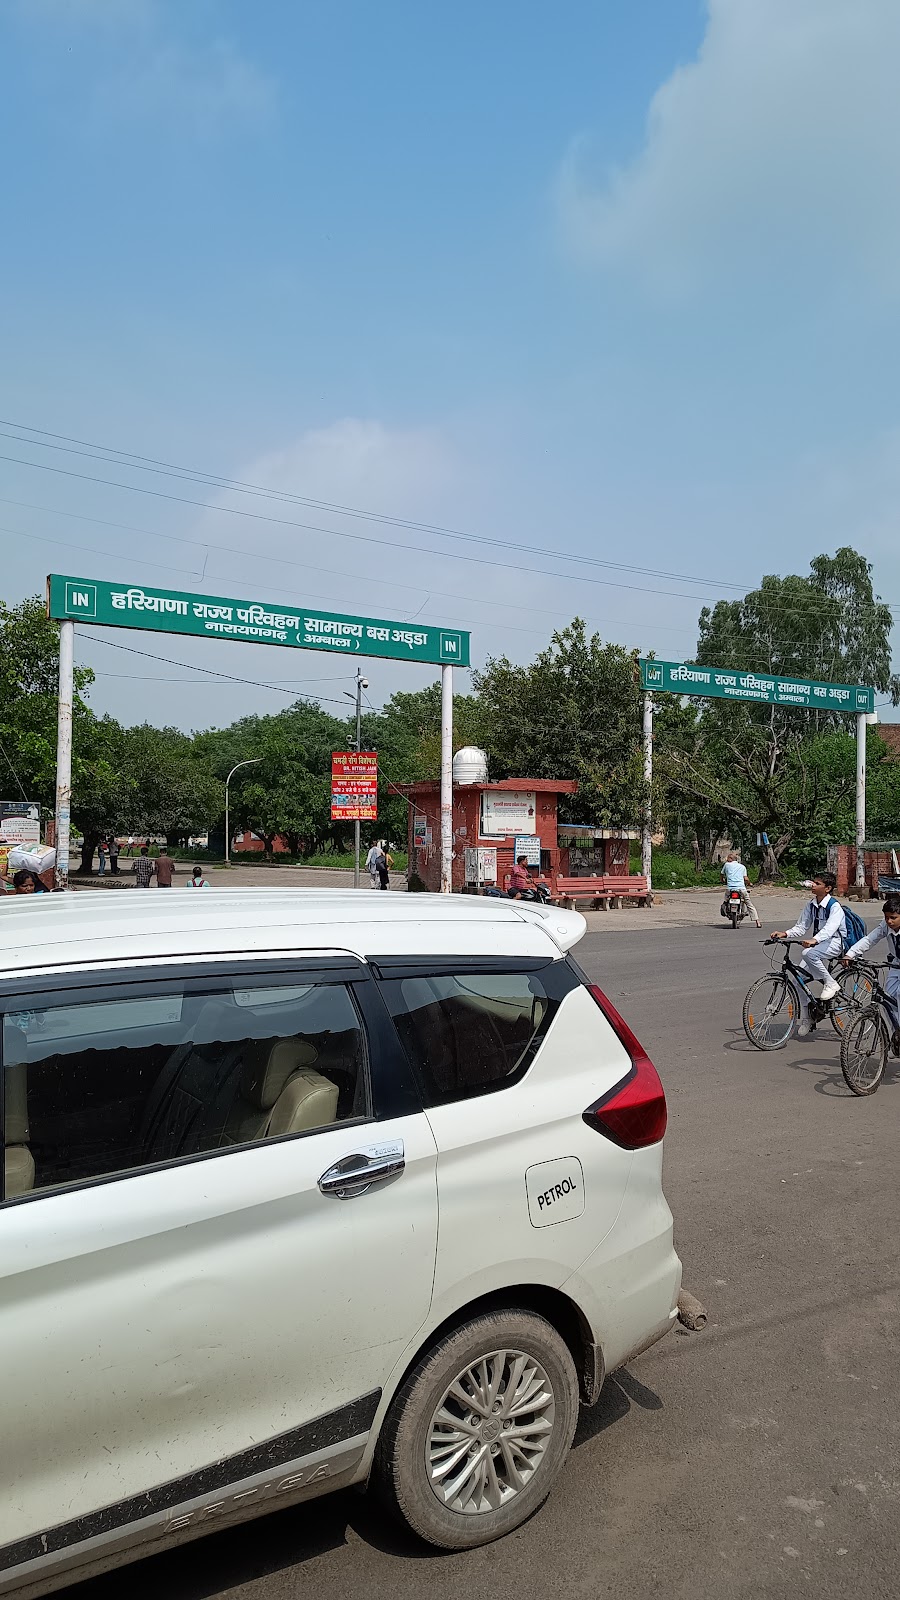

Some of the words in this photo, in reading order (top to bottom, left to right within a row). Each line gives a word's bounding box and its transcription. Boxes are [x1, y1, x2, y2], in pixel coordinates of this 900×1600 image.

[72, 591, 89, 607] IN
[110, 588, 189, 616] हरियाणा
[192, 602, 234, 622] राज्य
[236, 605, 300, 630] परिवहन
[304, 616, 364, 638] सामान्य
[366, 625, 390, 642] बस
[204, 621, 288, 642] नारायणगढ़
[444, 640, 457, 653] IN
[648, 669, 661, 681] OUT
[669, 665, 711, 684] हरियाणा
[714, 674, 737, 687] राज्य
[739, 674, 775, 692] परिवहन
[777, 681, 811, 696] सामान्य
[813, 686, 828, 698] बस
[857, 694, 868, 704] OUT
[347, 756, 358, 765] रोग
[537, 1176, 577, 1211] PETROL
